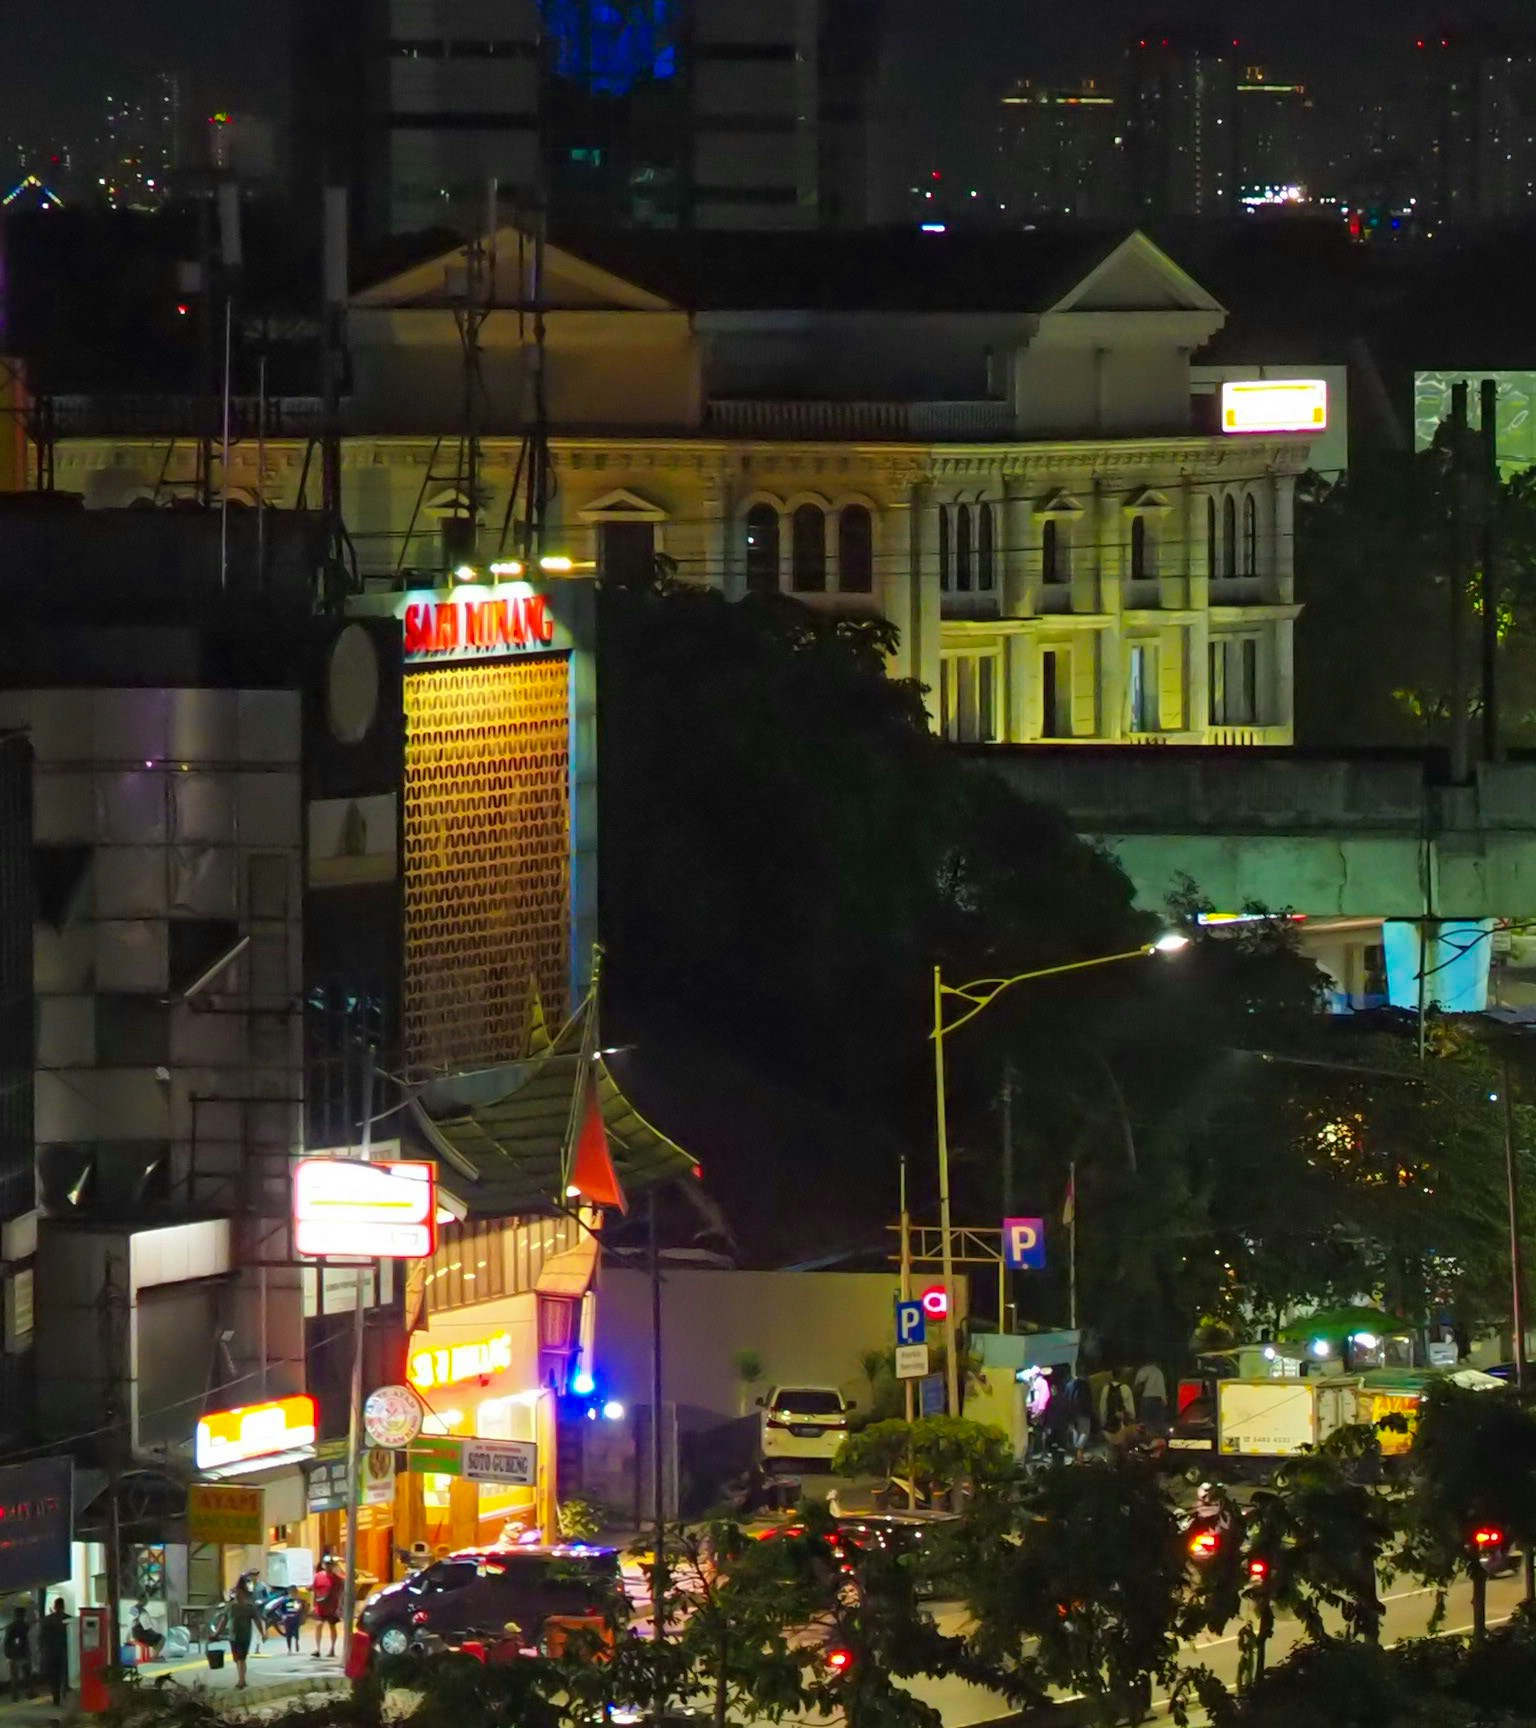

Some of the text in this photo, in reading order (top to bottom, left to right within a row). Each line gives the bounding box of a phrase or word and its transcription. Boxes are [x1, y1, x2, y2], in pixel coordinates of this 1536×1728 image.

[465, 595, 555, 648] MINANG
[1011, 1226, 1036, 1262] P
[901, 1308, 920, 1339] P
[468, 1451, 491, 1471] SOTO
